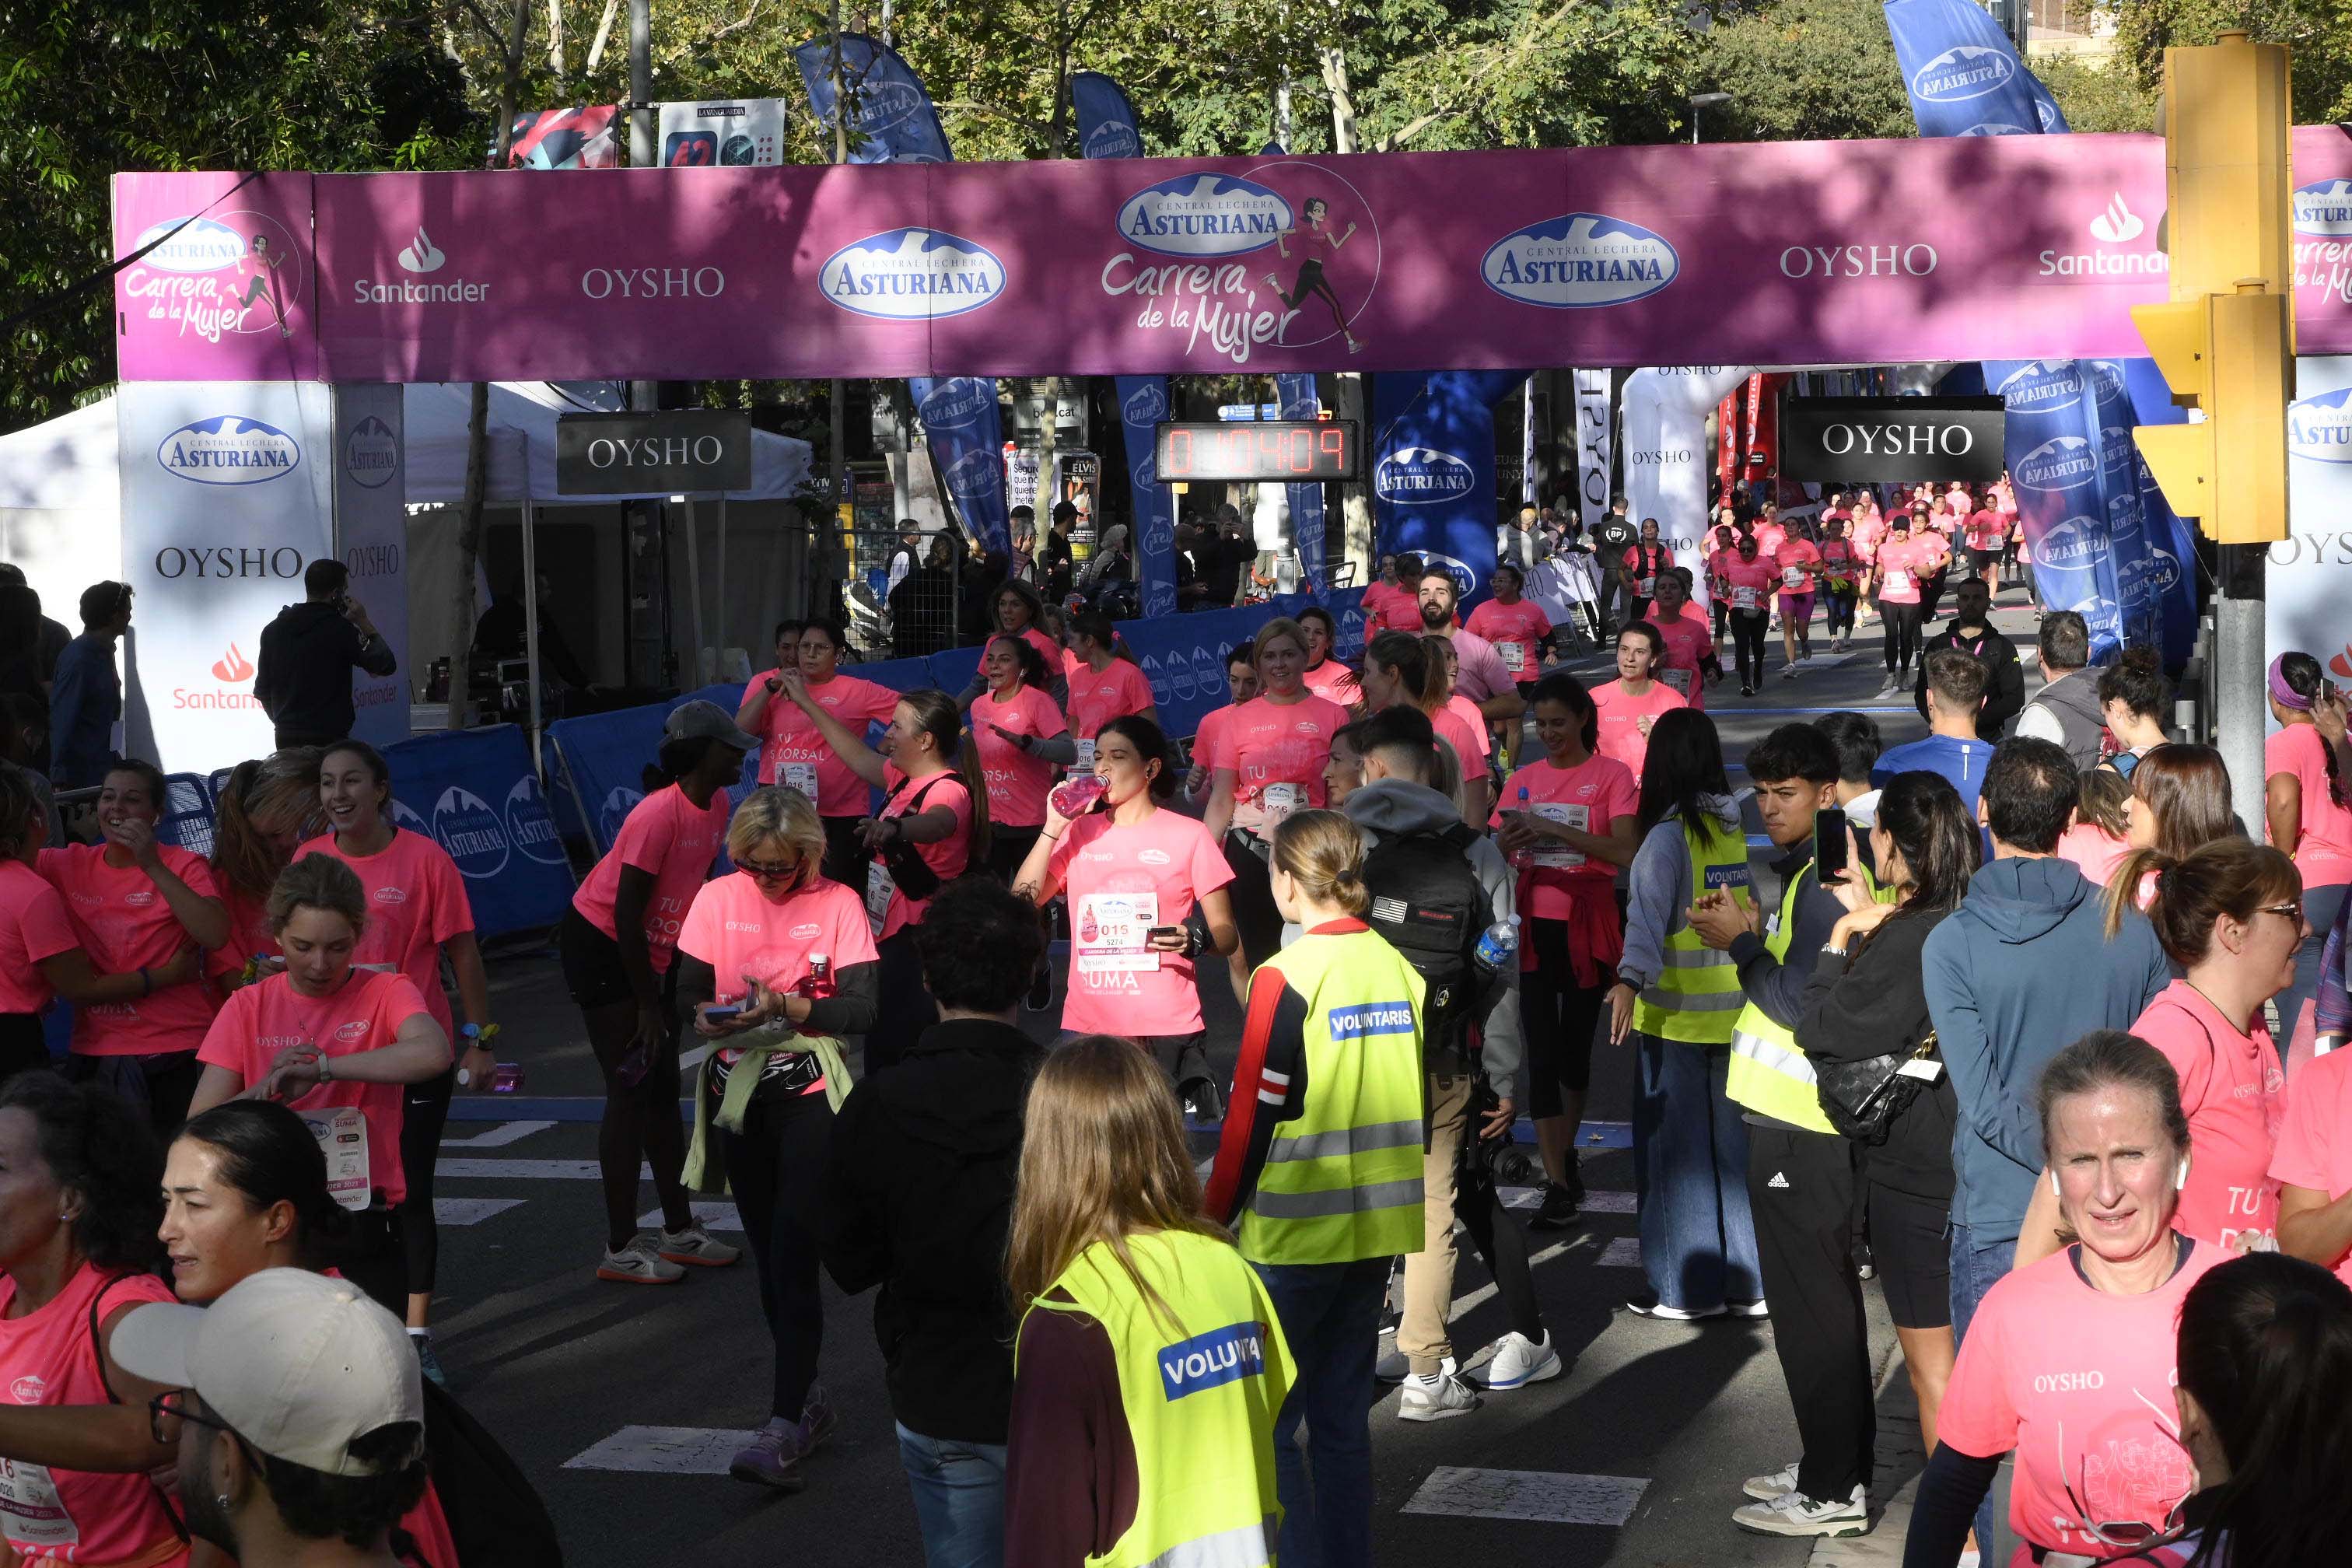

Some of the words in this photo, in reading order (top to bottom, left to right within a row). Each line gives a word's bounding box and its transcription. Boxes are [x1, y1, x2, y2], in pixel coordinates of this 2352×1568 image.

[706, 107, 744, 116] VANGUARDIA
[1157, 201, 1213, 211] CENTRAL
[1218, 200, 1274, 210] LECHERA
[1130, 204, 1280, 236] ASTURIANA
[1527, 246, 1587, 256] CENTRAL
[1594, 244, 1657, 255] LECHERA
[1780, 243, 1938, 278] OYSHO
[863, 258, 922, 269] CENTRAL
[927, 257, 985, 268] LECHERA
[1101, 253, 1248, 296] Carrera
[1496, 248, 1664, 285] ASTURIANA
[2312, 264, 2326, 285] la
[124, 268, 219, 298] Carrera
[355, 278, 490, 304] Santander
[582, 267, 725, 299] OYSHO
[834, 261, 992, 296] ASTURIANA
[149, 298, 165, 320] de
[169, 298, 181, 320] la
[180, 295, 254, 344] Mujer
[1137, 298, 1164, 328] de
[1170, 298, 1189, 328] la
[1185, 290, 1301, 364] Mujer
[190, 439, 236, 447] CENTRAL
[587, 436, 723, 468] OYSHO
[1822, 423, 1972, 457] OYSHO
[169, 442, 291, 467] ASTURIANA
[1632, 450, 1691, 466] OYSHO
[1072, 463, 1096, 474] ELVIS
[1379, 471, 1468, 492] ASTURIANA
[156, 546, 303, 579] OYSHO
[348, 544, 399, 579] OYSHO
[1251, 723, 1276, 734] OYSHO
[1247, 765, 1265, 780] TU
[988, 786, 1010, 797] MA
[439, 824, 506, 857] ASTURIANA
[513, 812, 557, 845] ASTUR
[661, 897, 682, 914] TU
[726, 921, 761, 933] OYSHO
[1332, 1010, 1412, 1033] VOLUNTARIS
[335, 1195, 362, 1205] ntander
[2228, 1186, 2263, 1215] TU
[2033, 1370, 2105, 1393] OYSHO
